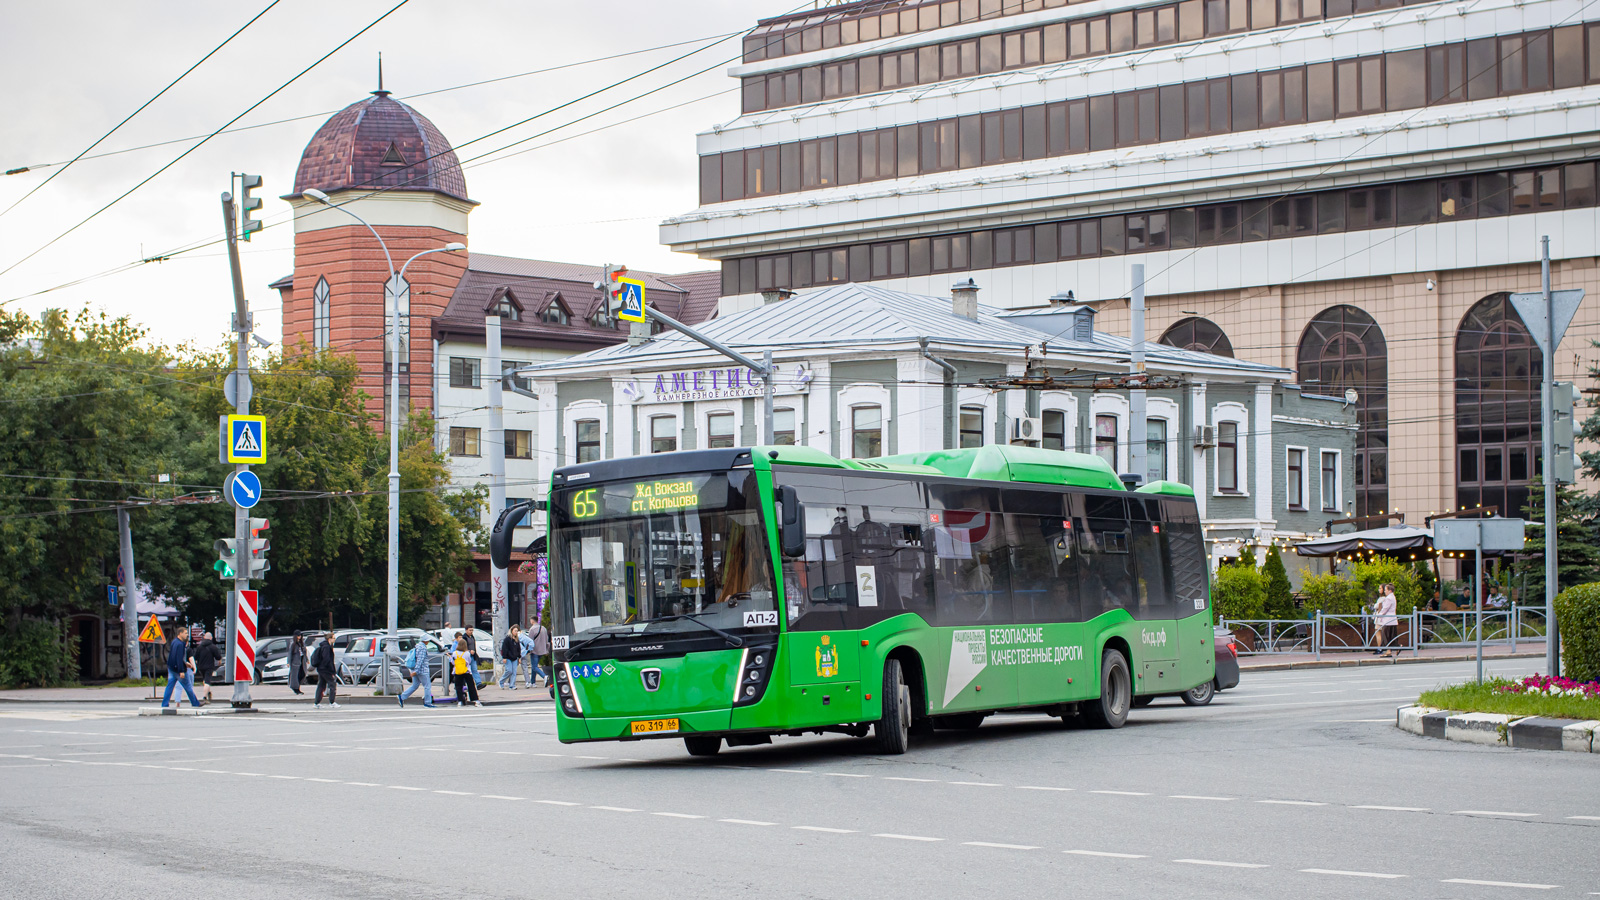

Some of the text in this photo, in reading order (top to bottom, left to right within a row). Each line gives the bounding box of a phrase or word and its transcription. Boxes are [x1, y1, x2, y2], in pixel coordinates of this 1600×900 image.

[653, 366, 778, 394] АМЕТИС
[657, 388, 777, 402] КАМНЕРЕЗНОЕ ИСКУССТО
[636, 481, 693, 498] Жд Вокзал
[573, 489, 598, 518] 65
[632, 495, 698, 512] ст. Кольцово
[747, 613, 775, 624] АП-2
[554, 637, 566, 648] 320
[954, 631, 985, 642] НАЦИОНАЛЬНЫЕ
[990, 628, 1044, 644] БЕЗОПАСНЫЕ
[1142, 627, 1166, 647] бкд.рф
[968, 643, 985, 653] ПРОЕКТЫ
[991, 646, 1083, 665] КАЧЕСТВЕННЫЕ ДОРОГИ
[648, 721, 664, 730] 319
[667, 719, 676, 727] 66
